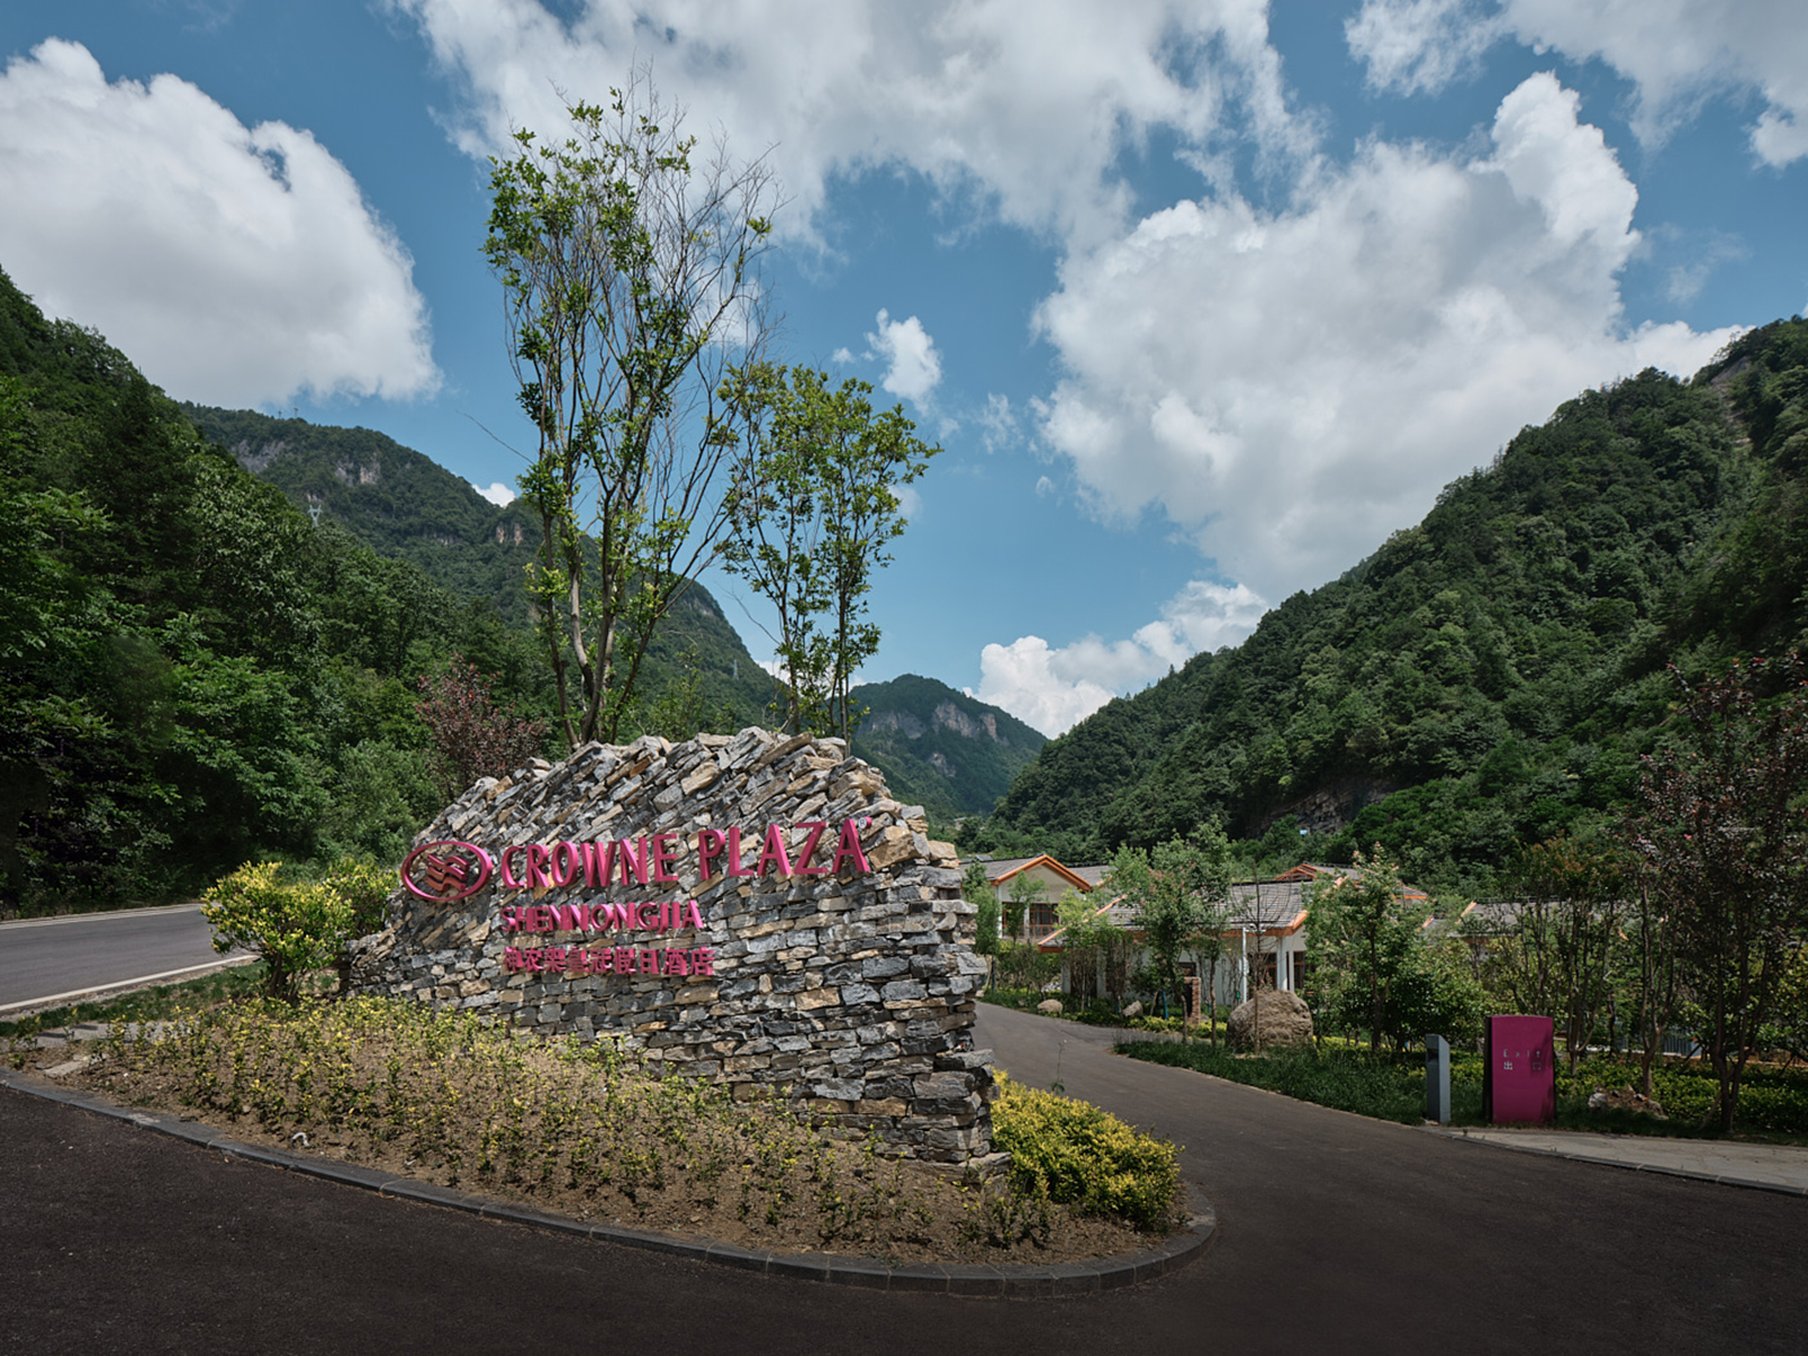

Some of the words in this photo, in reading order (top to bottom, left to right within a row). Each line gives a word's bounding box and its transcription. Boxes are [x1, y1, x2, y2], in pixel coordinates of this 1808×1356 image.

[500, 833, 679, 889] CROWNE
[698, 818, 872, 881] PLAZA
[500, 899, 704, 935] SHENNONGJIA
[504, 945, 716, 976] 神农架皇冠假日酒店
